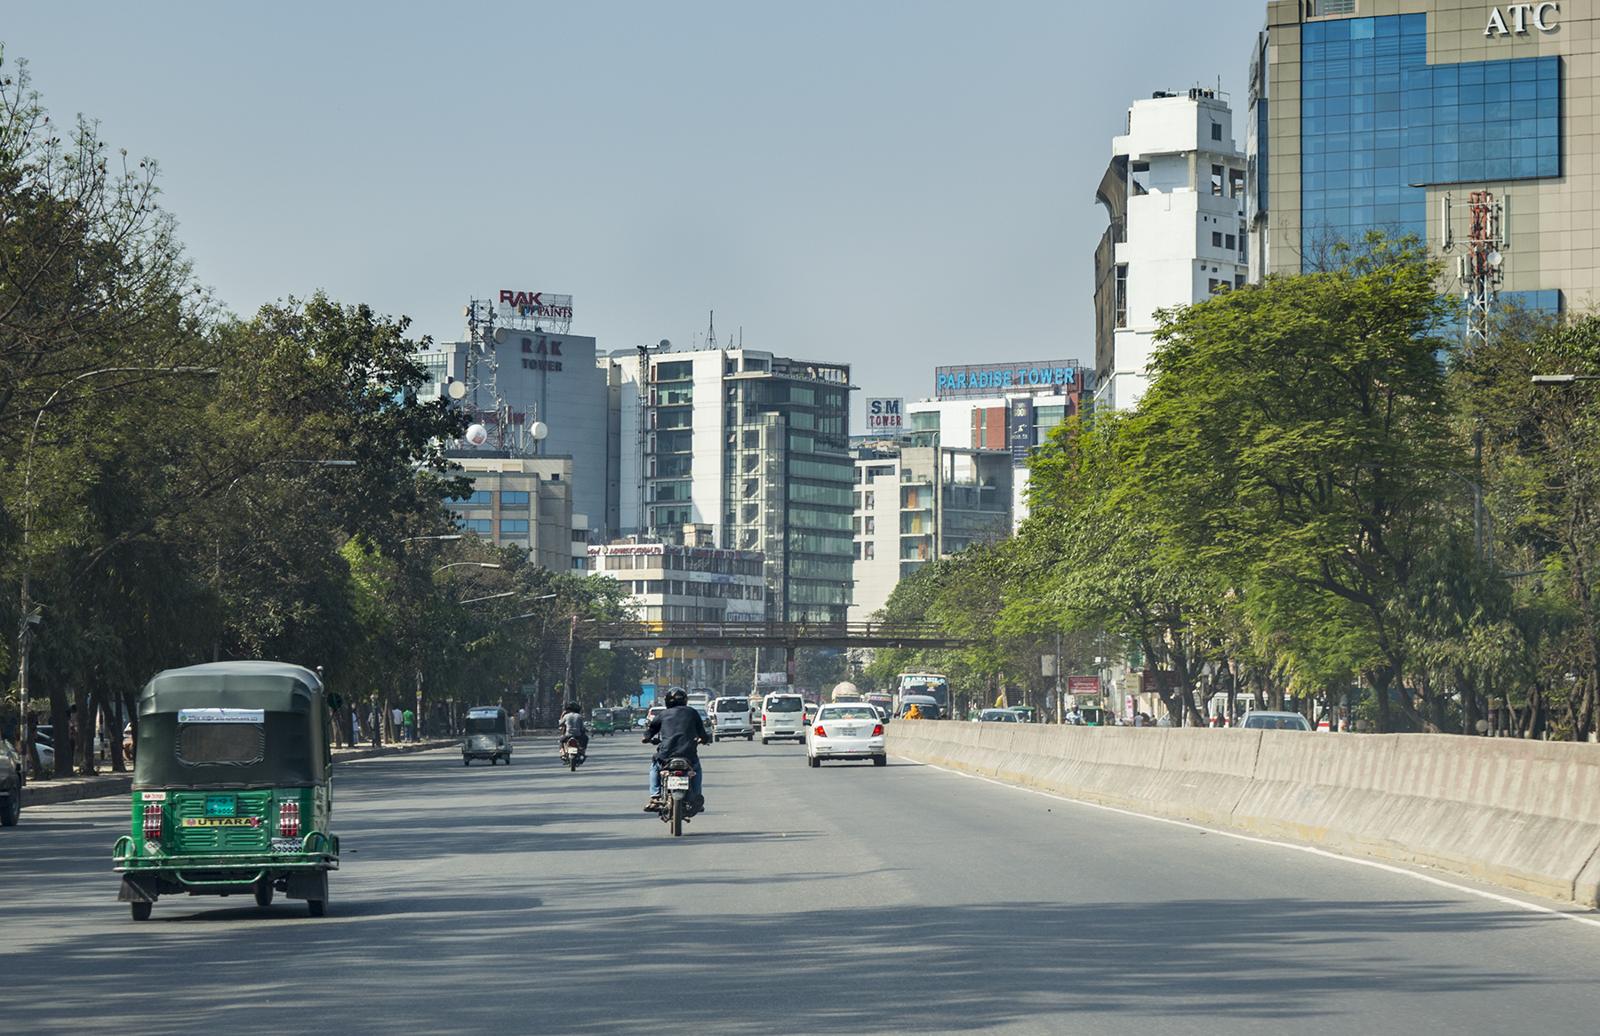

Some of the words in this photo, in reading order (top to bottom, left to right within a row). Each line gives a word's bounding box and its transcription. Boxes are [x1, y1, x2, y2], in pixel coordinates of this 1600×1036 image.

[1483, 2, 1557, 35] ATC
[500, 290, 542, 307] RAK
[522, 337, 562, 356] RAK
[521, 358, 562, 372] TOWER
[937, 370, 1013, 390] PARADISE
[1018, 367, 1076, 386] TOWER
[869, 415, 902, 427] TOWER
[199, 818, 253, 826] UTTARA
